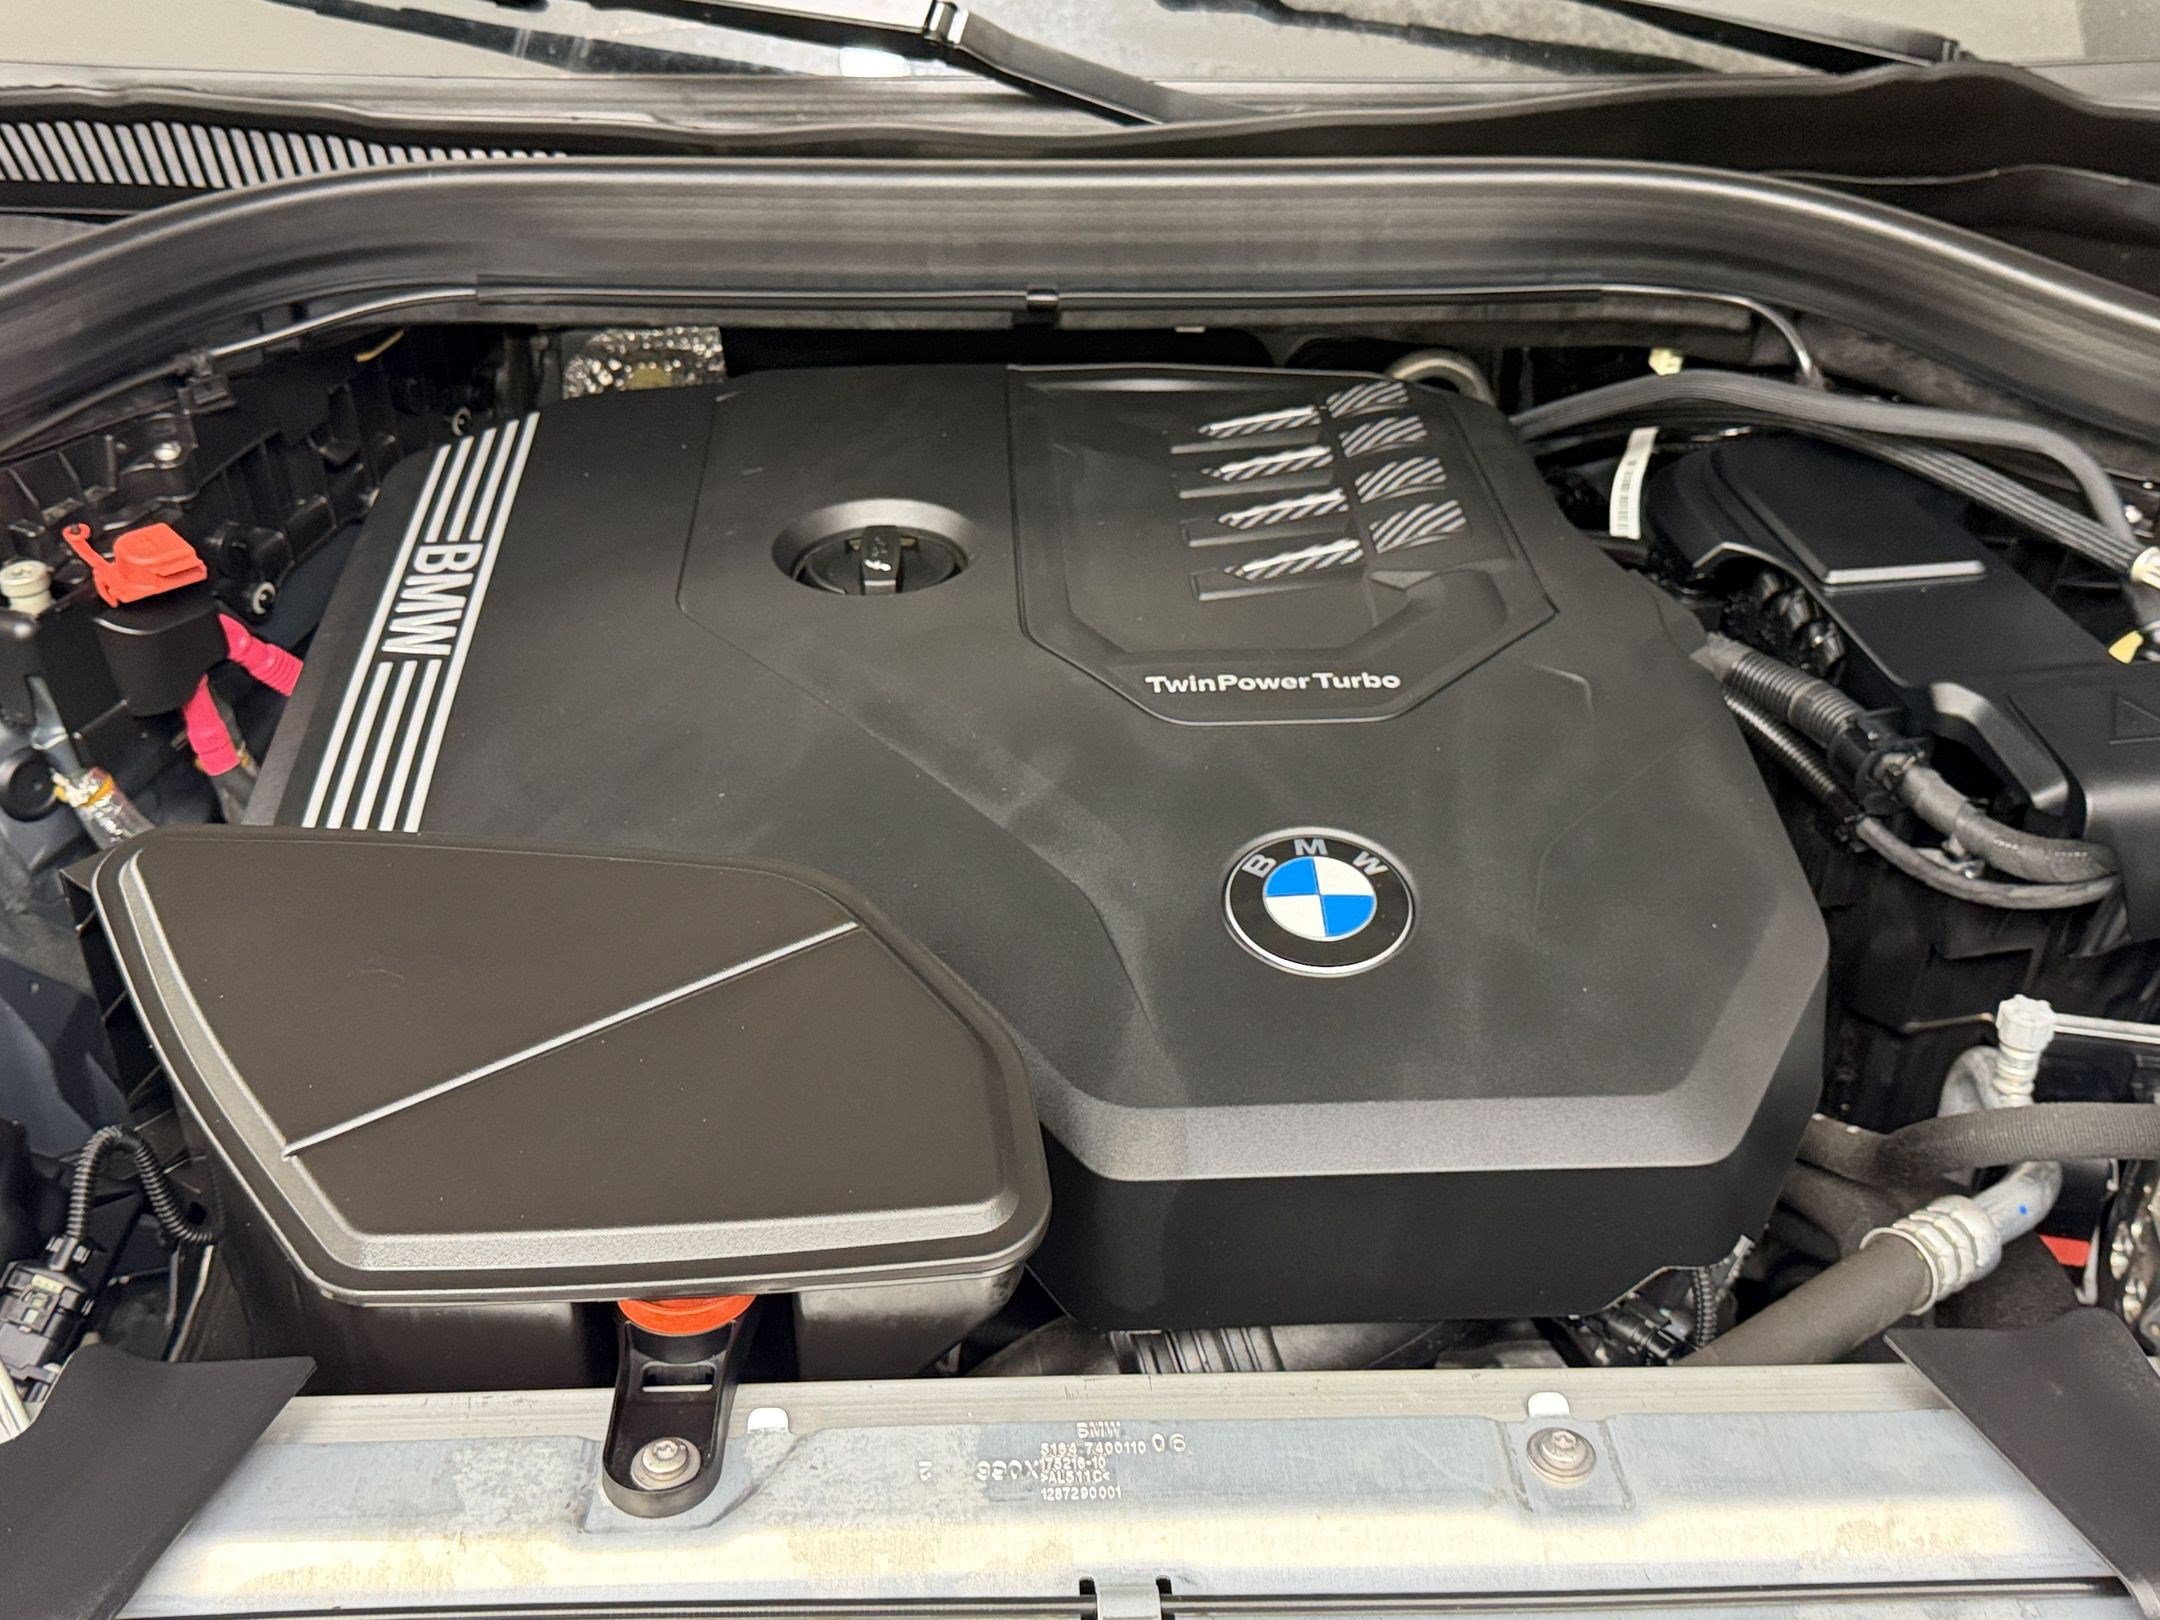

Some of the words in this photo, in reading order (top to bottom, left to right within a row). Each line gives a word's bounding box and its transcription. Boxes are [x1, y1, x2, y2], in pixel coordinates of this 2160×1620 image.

[381, 543, 483, 655] BMW
[1145, 673, 1311, 694] TwinPower
[1312, 672, 1401, 690] Turbo
[1241, 838, 1389, 879] BMW
[1076, 1421, 1121, 1439] BMW
